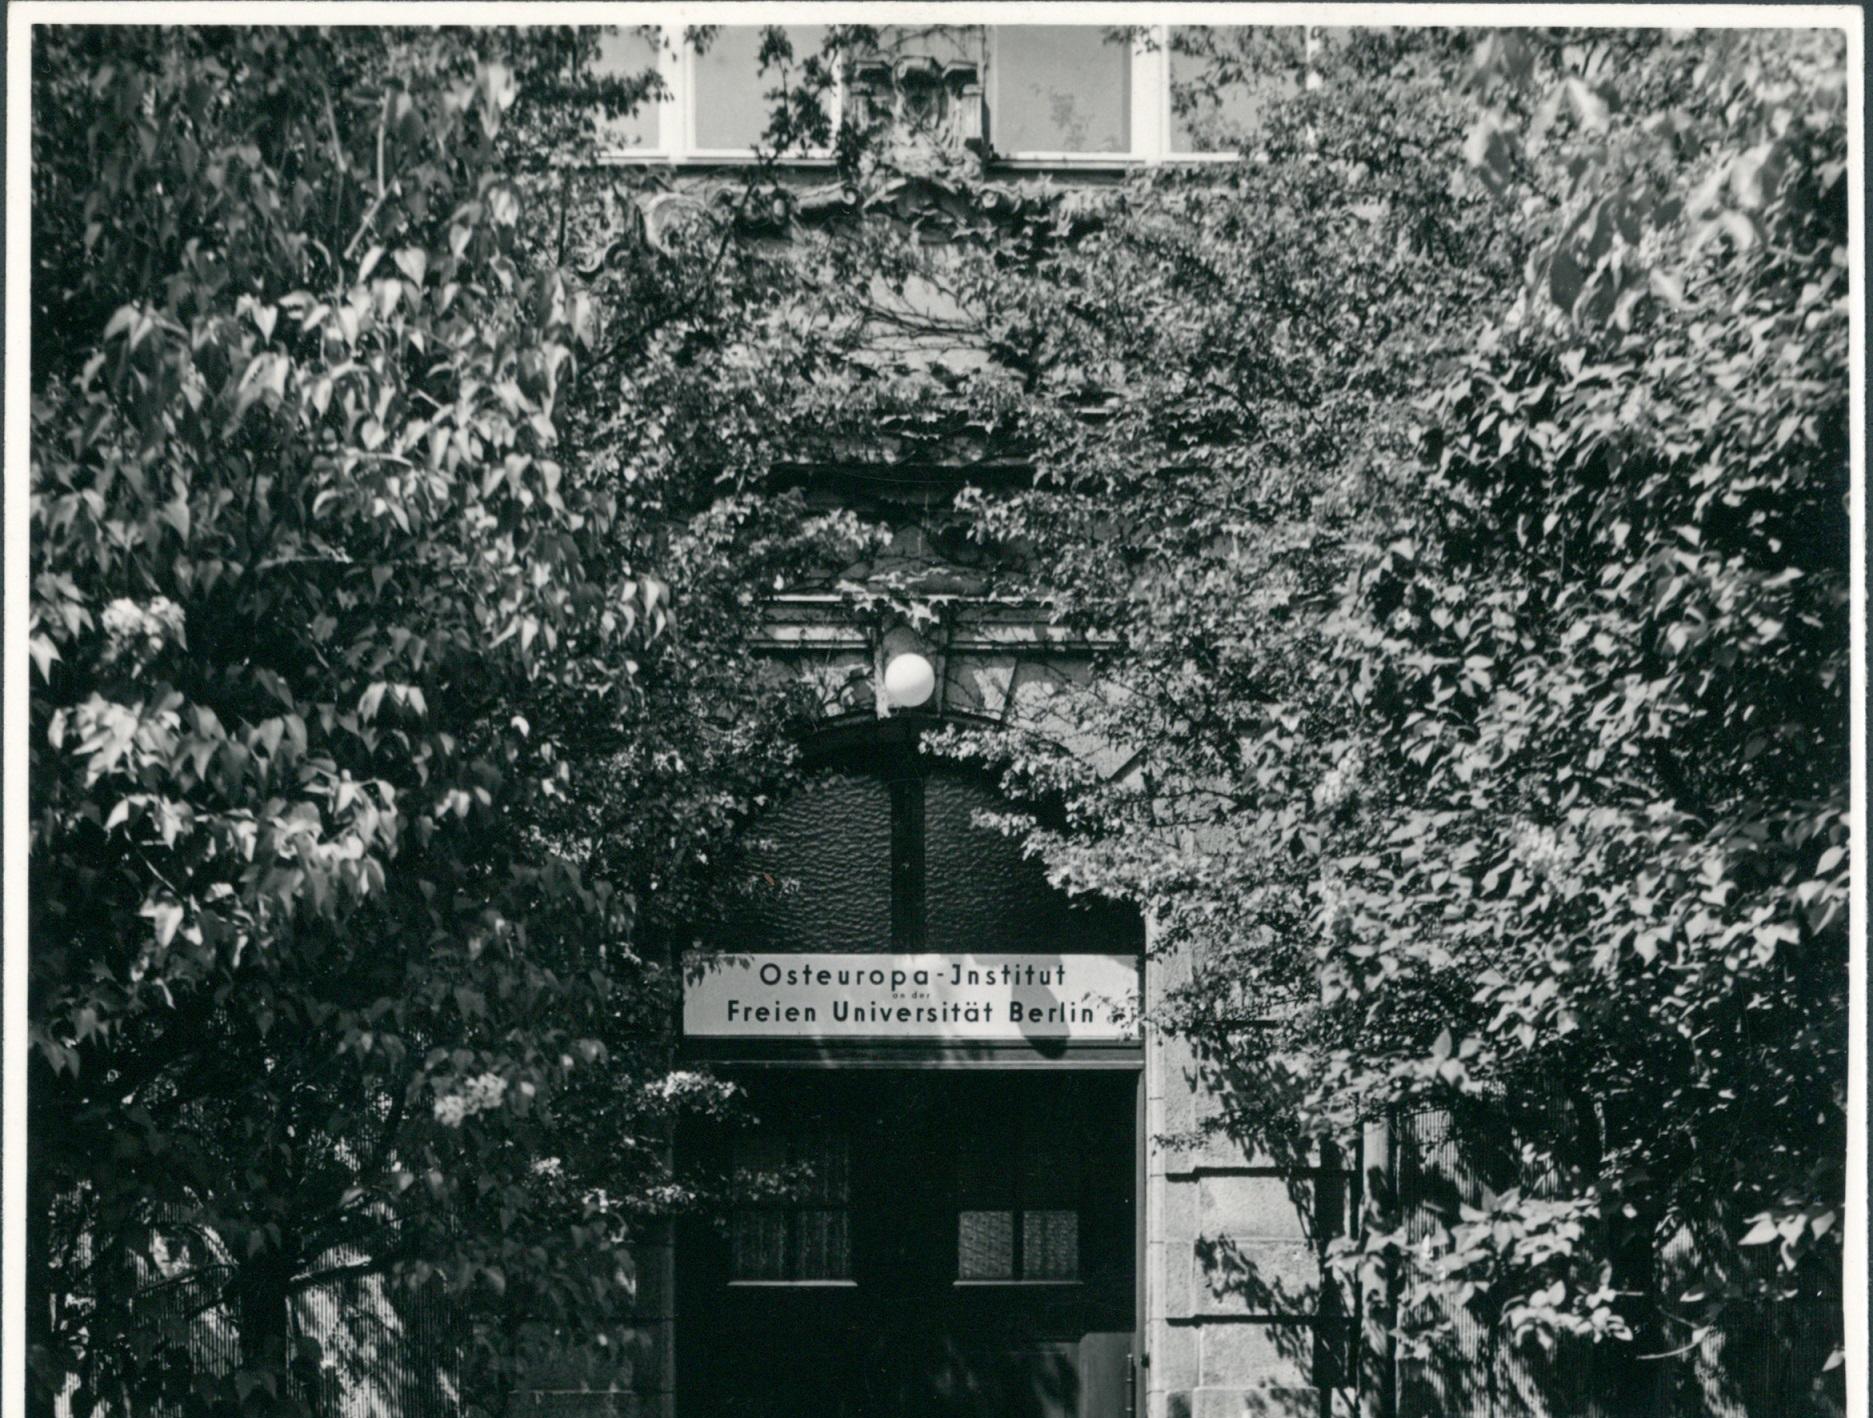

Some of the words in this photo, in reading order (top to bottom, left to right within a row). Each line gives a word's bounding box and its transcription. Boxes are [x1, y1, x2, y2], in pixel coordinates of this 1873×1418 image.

[911, 990, 930, 999] der
[728, 1000, 816, 1022] Freien
[833, 1001, 993, 1022] Universität
[1010, 1001, 1093, 1022] Berlin
